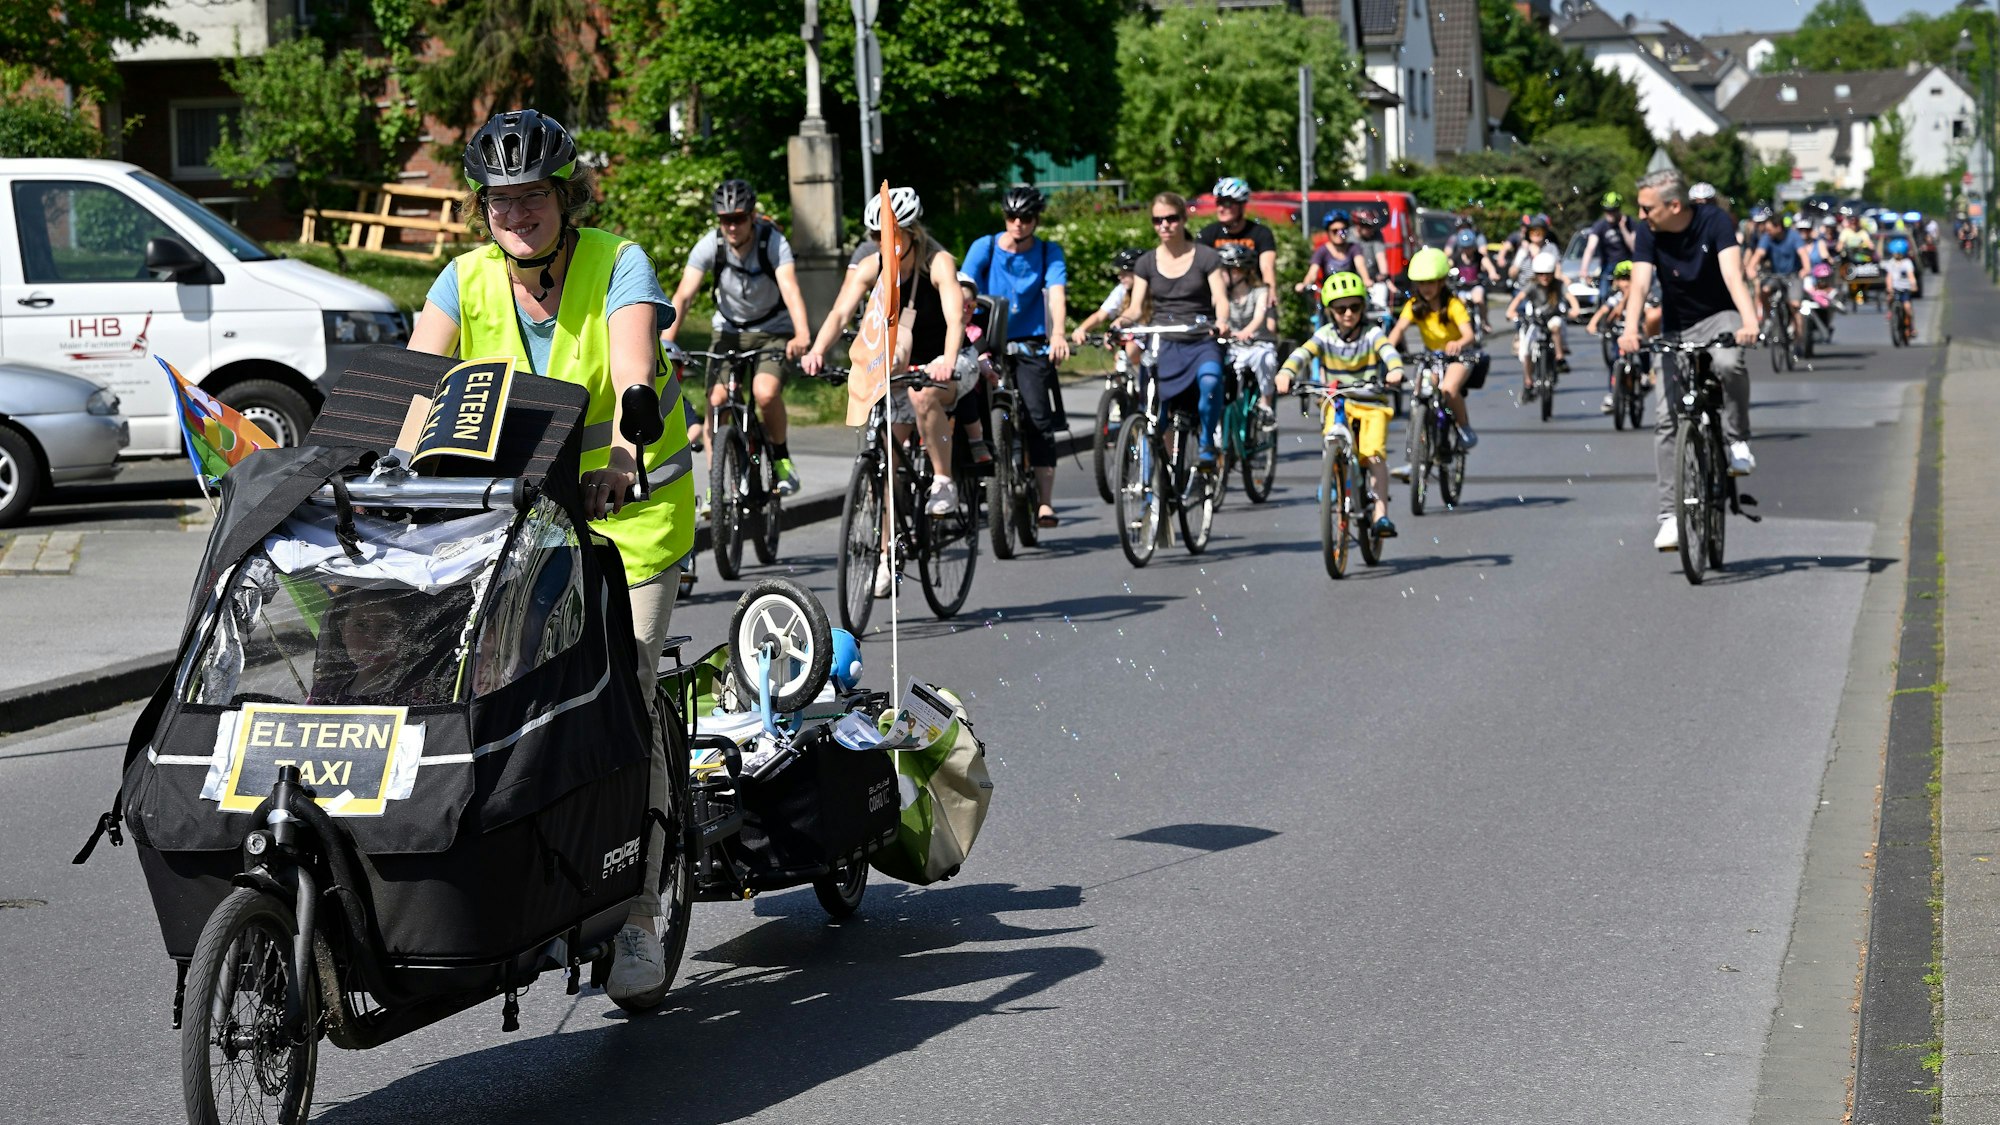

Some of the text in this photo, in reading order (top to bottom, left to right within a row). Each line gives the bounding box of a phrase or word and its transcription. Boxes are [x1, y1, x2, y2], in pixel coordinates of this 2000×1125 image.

[70, 317, 122, 338] IHB
[452, 371, 494, 441] ELTERN
[251, 721, 391, 749] ELTERN
